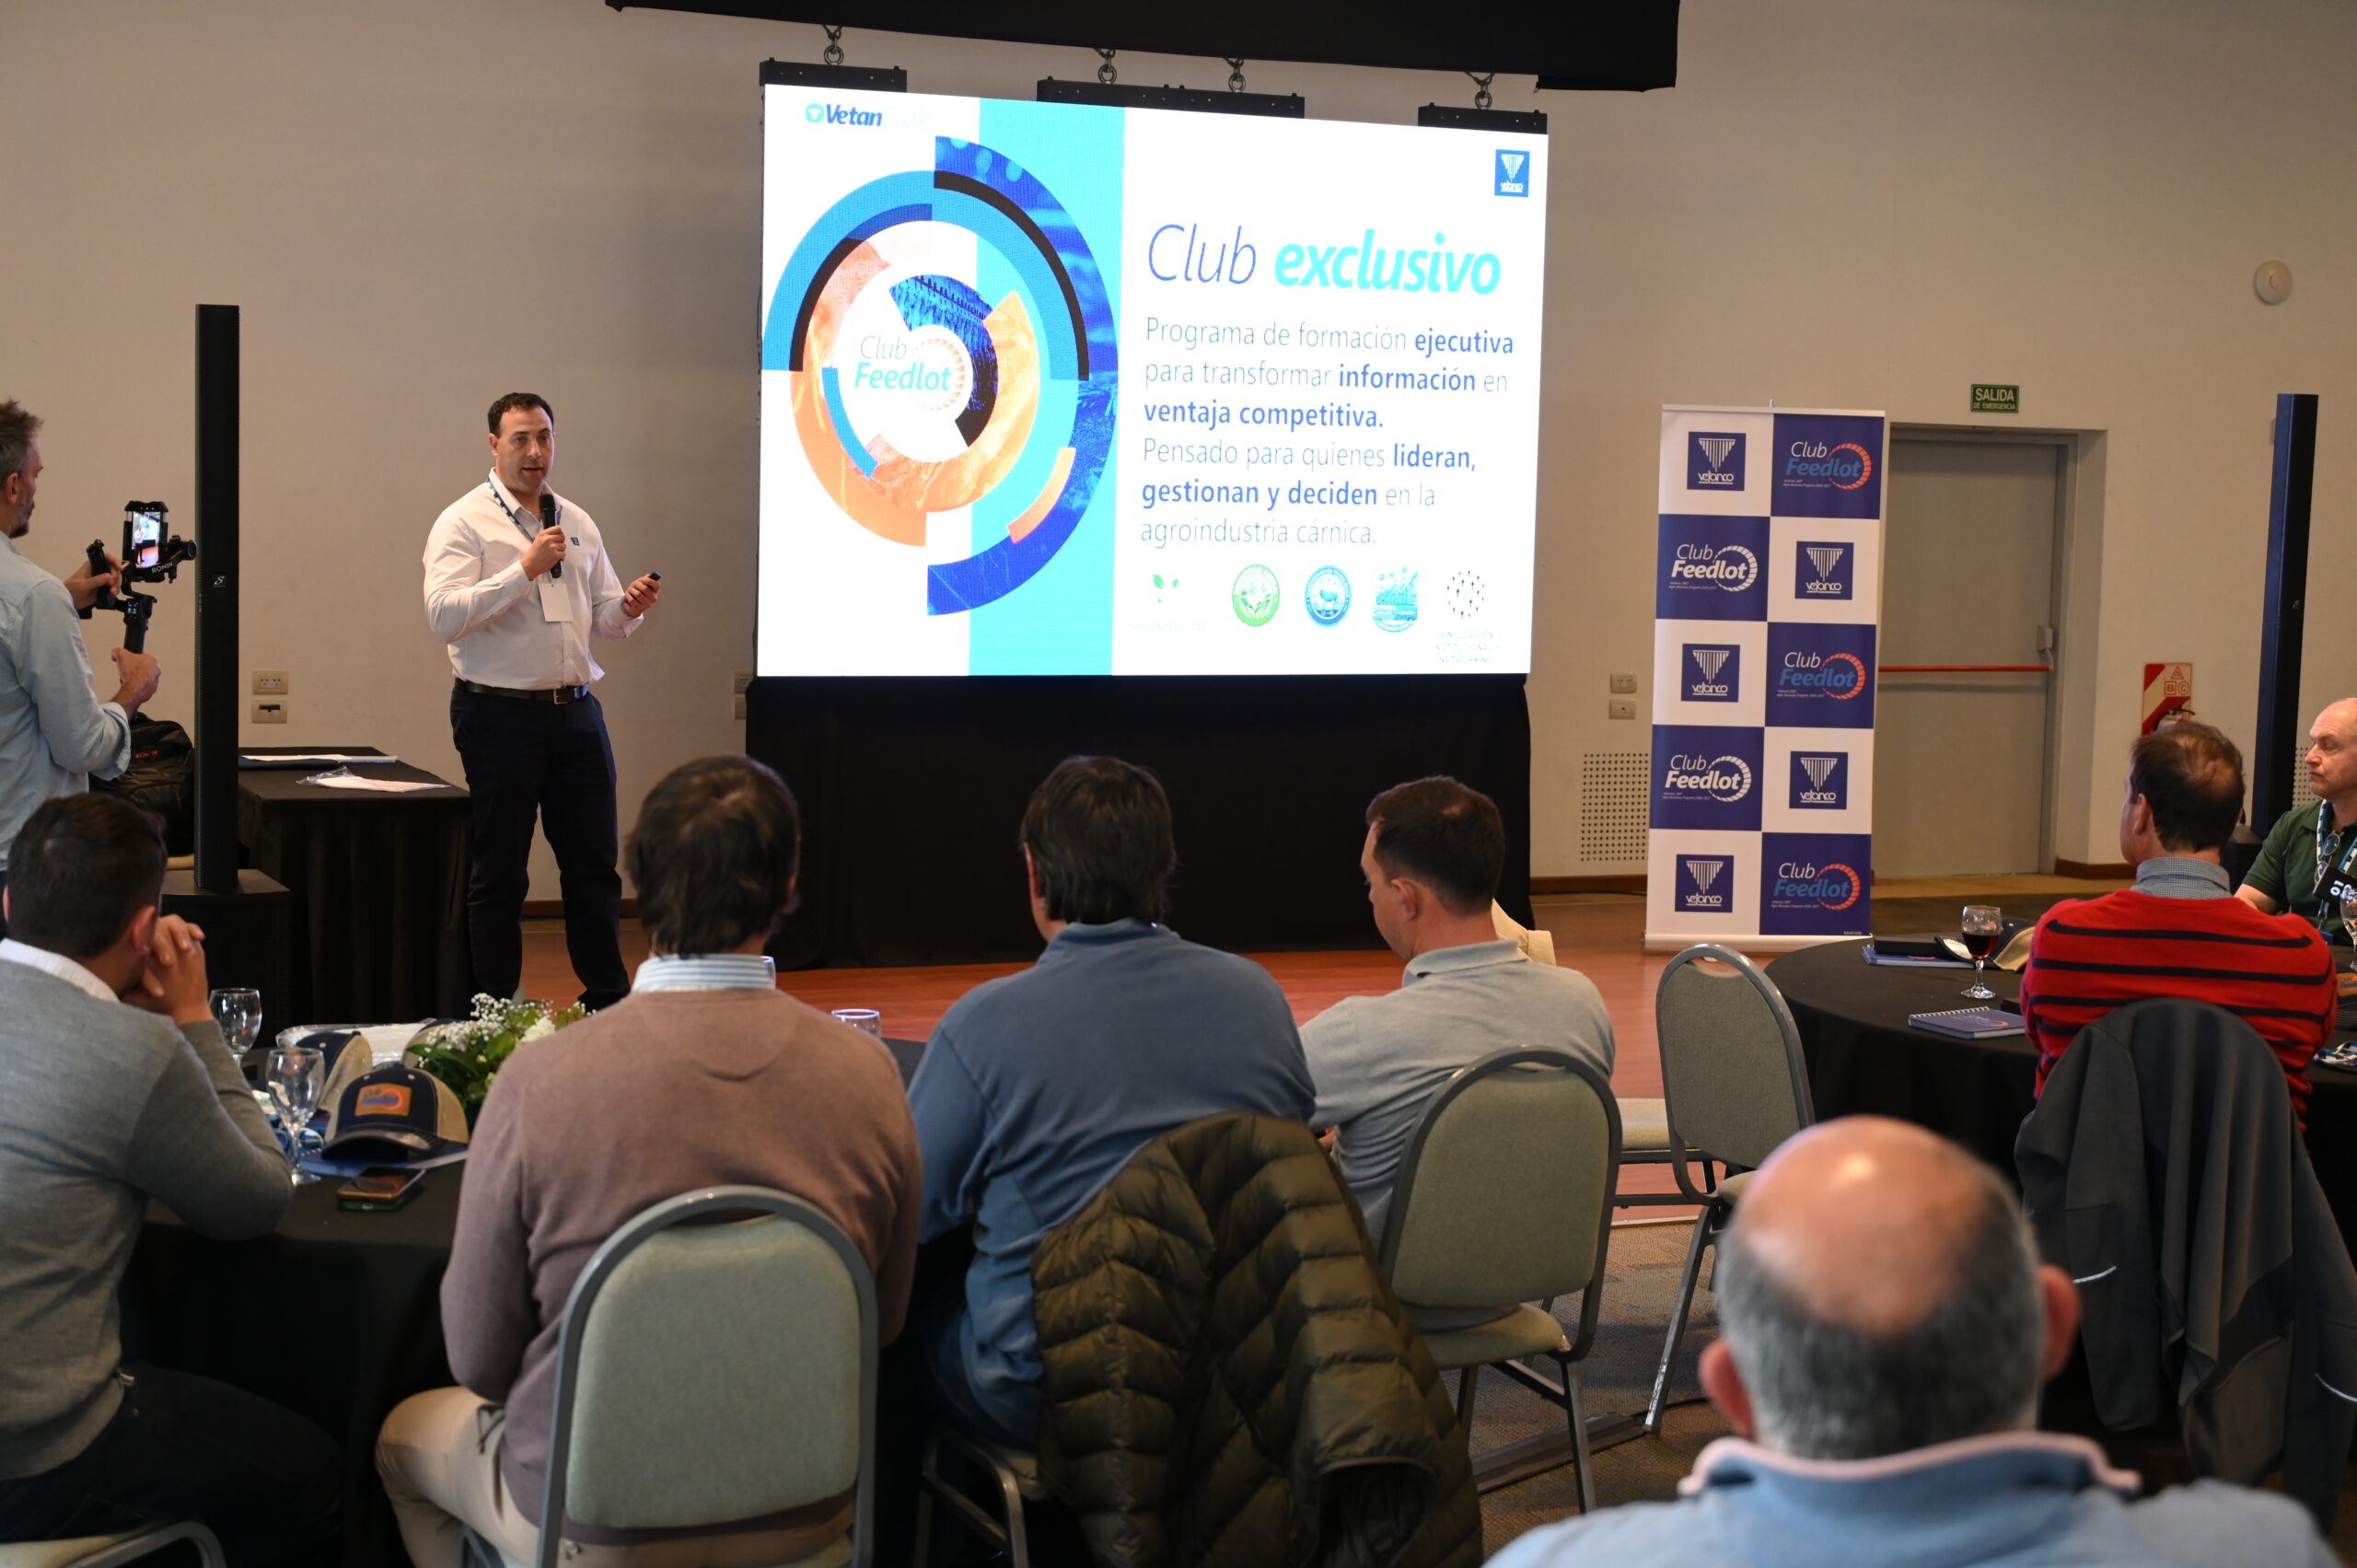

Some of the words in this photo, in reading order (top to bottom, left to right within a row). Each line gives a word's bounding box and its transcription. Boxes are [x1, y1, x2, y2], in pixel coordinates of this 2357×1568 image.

[1147, 223, 1257, 285] Club
[1274, 227, 1502, 296] exclusivo
[860, 335, 907, 360] Club
[1146, 317, 1255, 351] Programa
[1263, 321, 1290, 346] de
[1298, 321, 1406, 351] formación
[1414, 328, 1514, 358] ejecutiva
[854, 361, 952, 391] Feedlot
[1145, 362, 1194, 389] para
[1202, 360, 1332, 387] transformar
[1339, 364, 1476, 391] información
[1483, 374, 1508, 392] en
[1975, 388, 2014, 402] SALIDA
[1144, 399, 1231, 431] ventaja
[1239, 402, 1384, 433] competitiva.
[1144, 437, 1237, 465] Pensado
[1247, 446, 1294, 471] para
[1302, 442, 1385, 472] quienes
[1393, 443, 1475, 472] lideran,
[1791, 441, 1828, 459] Club
[1785, 458, 1862, 478] Feedlot
[1142, 479, 1260, 509] gestionan
[1267, 486, 1280, 511] y
[1288, 480, 1377, 505] deciden
[1386, 487, 1411, 506] en
[1419, 482, 1435, 506] la
[1141, 517, 1288, 550] agroindustria
[1677, 543, 1713, 561] Club
[151, 562, 173, 574] RONIN
[1671, 560, 1747, 580] Feedlot
[1784, 651, 1821, 668] Club
[1779, 668, 1856, 688] Feedlot
[1670, 754, 1707, 772] Club
[1665, 770, 1741, 790] Feedlot
[1779, 862, 1816, 879] Club
[1773, 877, 1851, 898] Feedlot
